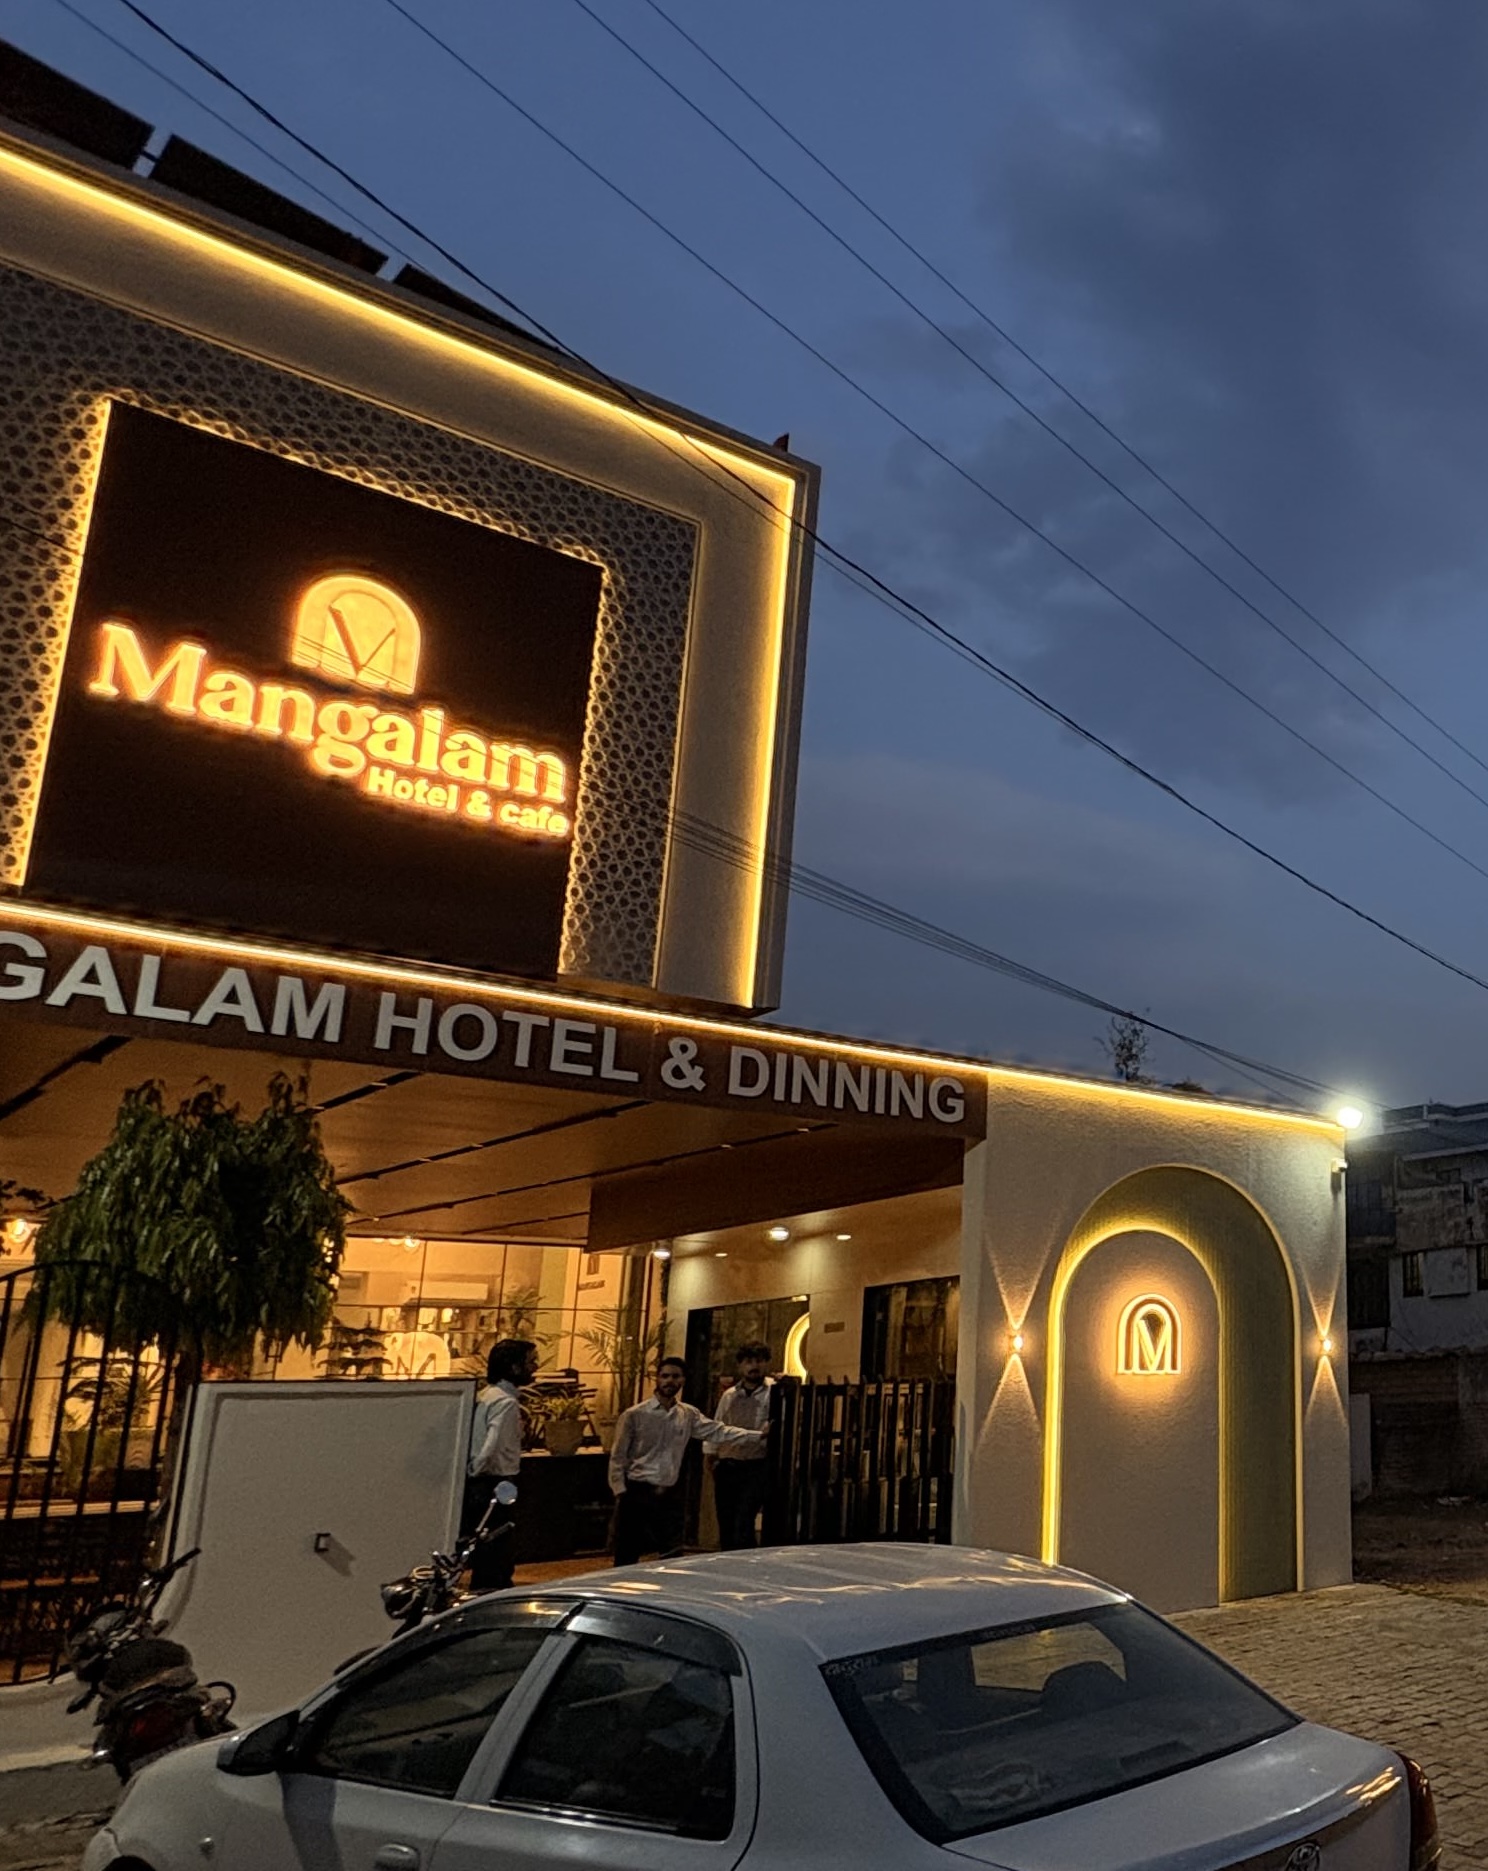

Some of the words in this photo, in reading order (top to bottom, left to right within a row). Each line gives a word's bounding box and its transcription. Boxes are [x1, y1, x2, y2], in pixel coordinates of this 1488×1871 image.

[89, 621, 568, 803] Mangalam
[367, 766, 459, 812] Hotel
[466, 790, 492, 818] &
[499, 802, 570, 836] cafe
[373, 1001, 639, 1084] HOTEL
[660, 1036, 706, 1092] &
[728, 1046, 967, 1124] DINNING
